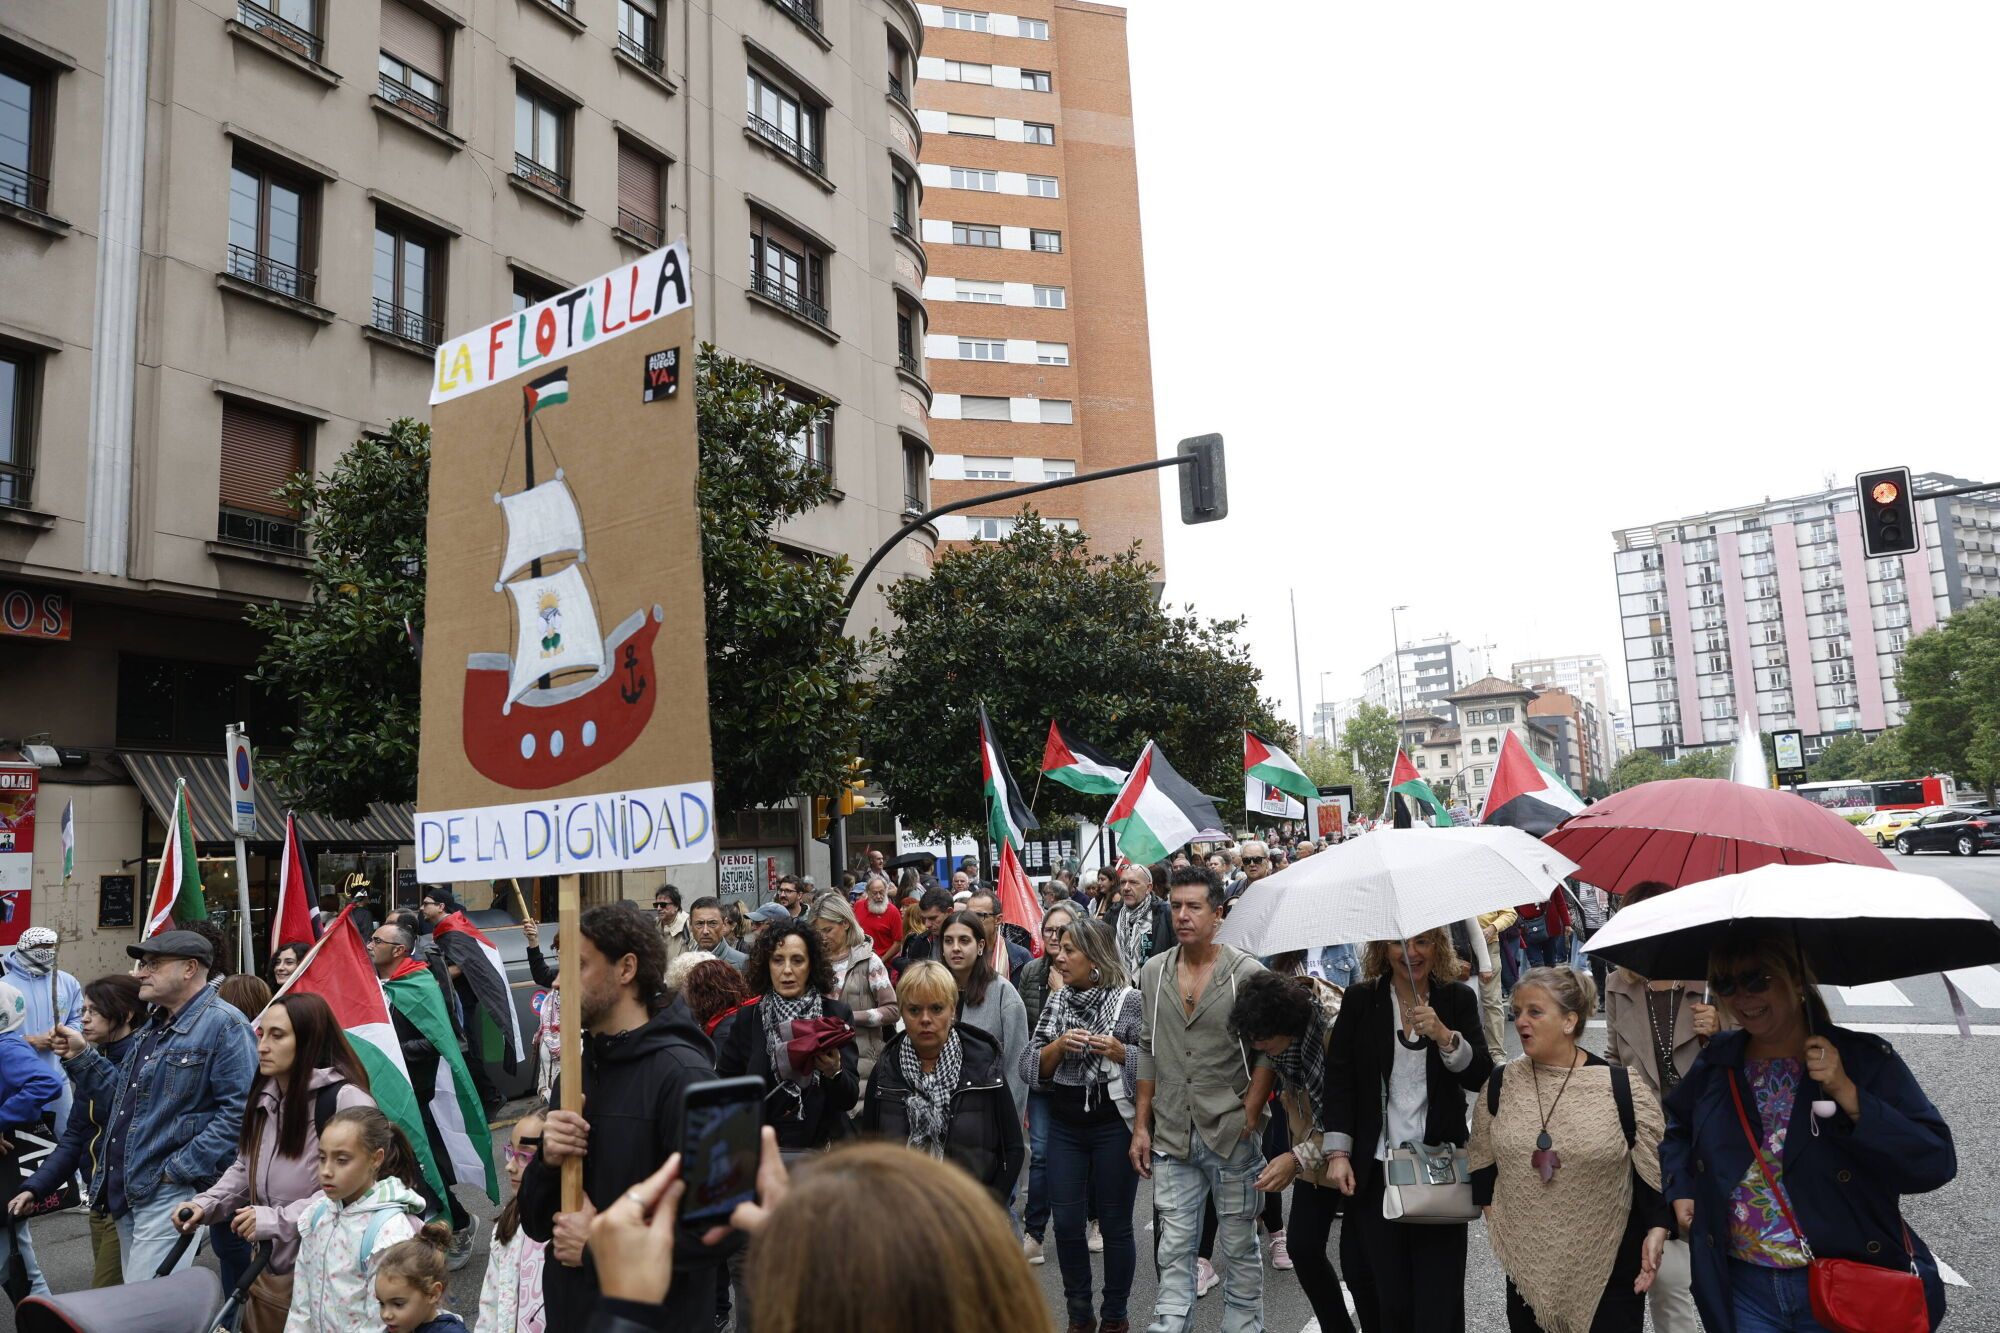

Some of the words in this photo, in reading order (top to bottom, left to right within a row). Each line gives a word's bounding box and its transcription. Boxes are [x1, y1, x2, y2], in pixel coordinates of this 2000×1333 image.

[649, 352, 666, 362] ALTO
[667, 350, 675, 358] EL
[438, 343, 473, 393] LA
[649, 358, 675, 371] FUEGO
[3, 590, 62, 635] OS
[421, 816, 466, 864] DE
[476, 815, 508, 862] LA
[720, 855, 754, 865] VENDE
[721, 870, 753, 883] ASTURIAS
